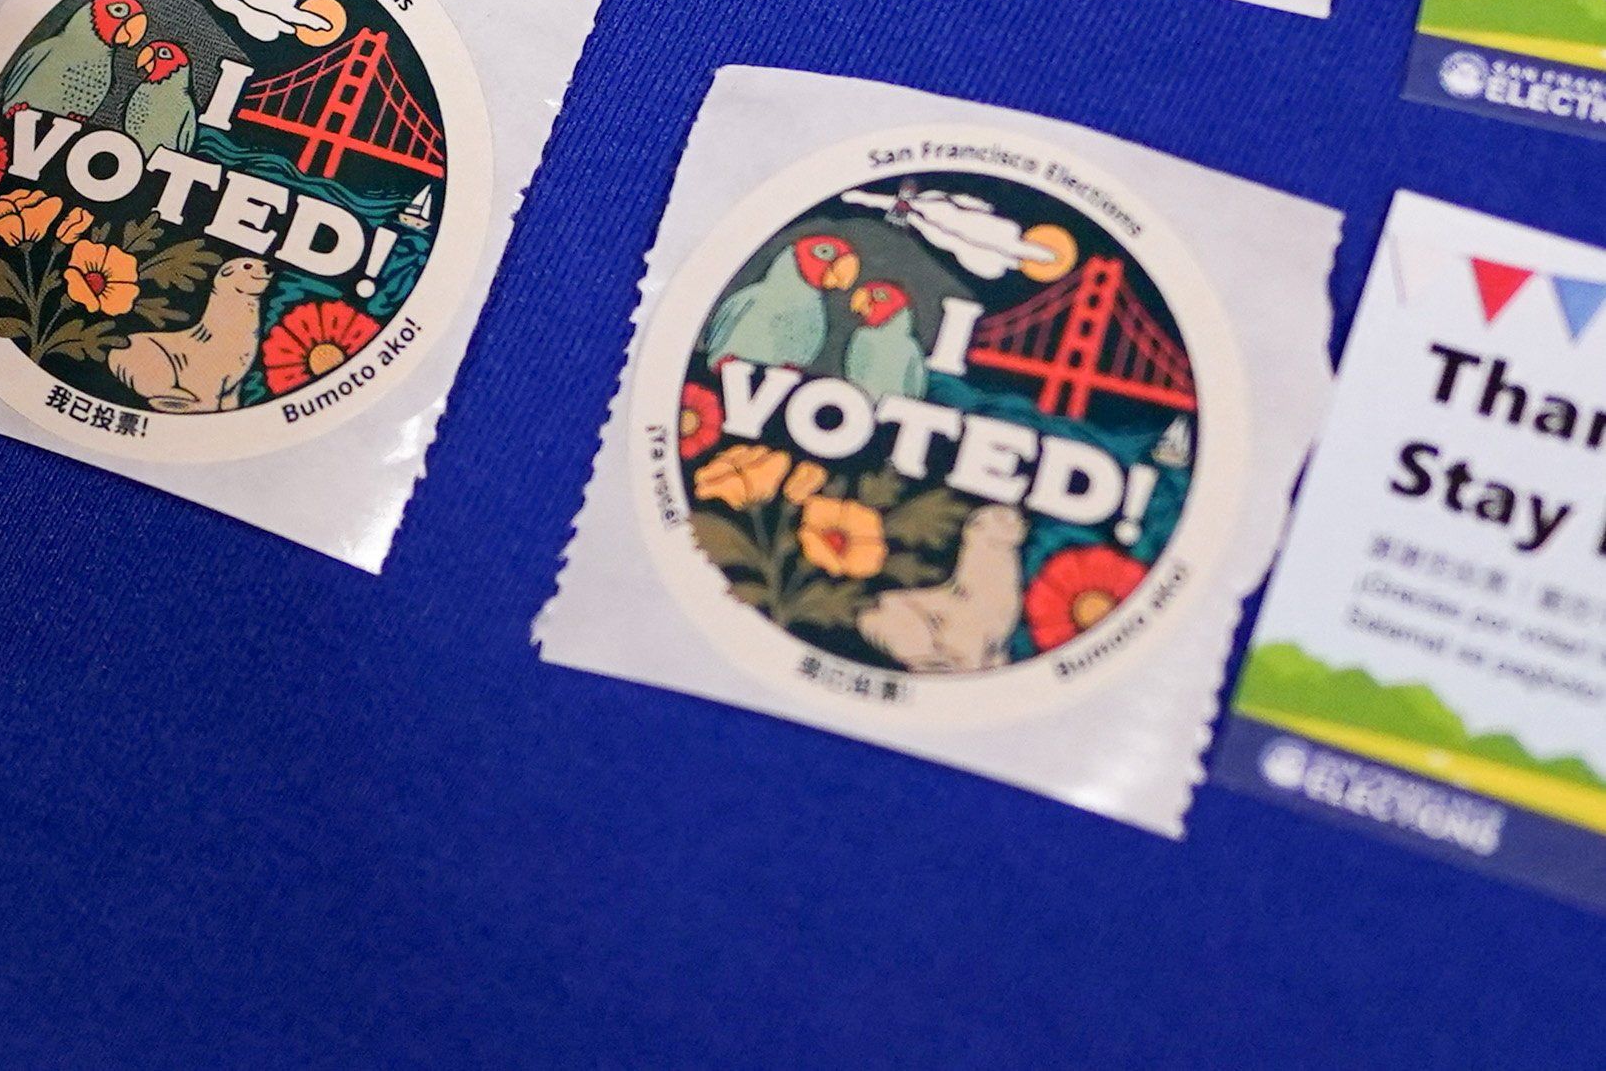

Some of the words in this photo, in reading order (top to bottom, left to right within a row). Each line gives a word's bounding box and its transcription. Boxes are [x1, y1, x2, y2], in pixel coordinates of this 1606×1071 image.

[198, 58, 254, 130] I
[7, 110, 397, 297] VOTED!
[867, 147, 914, 168] San
[282, 365, 375, 425] Bumoto
[378, 317, 424, 366] ako!
[927, 296, 984, 374] I
[44, 384, 150, 438] 我已投票!
[719, 360, 1158, 546] VOTED!
[1390, 441, 1571, 552] Stay
